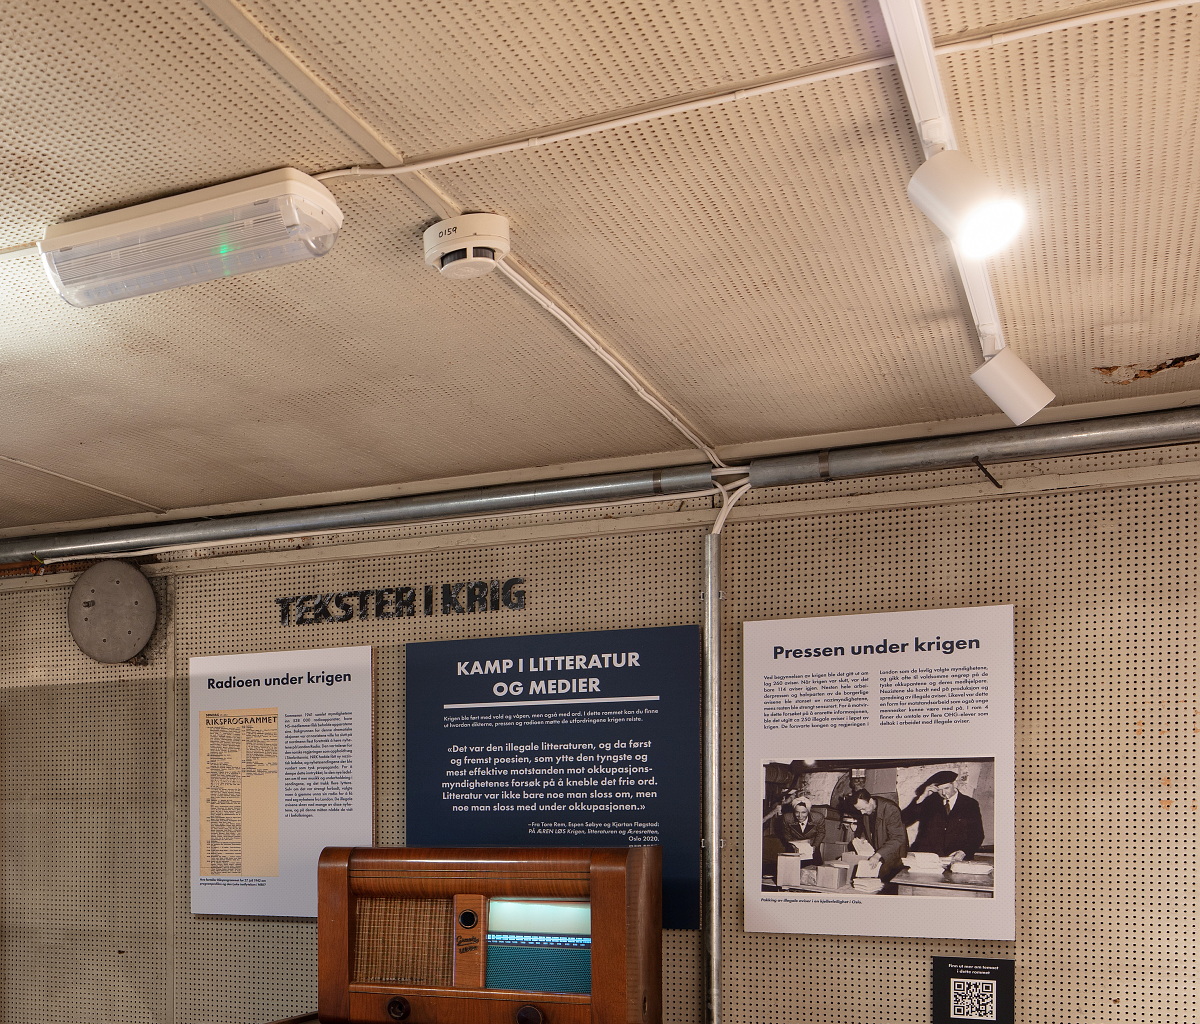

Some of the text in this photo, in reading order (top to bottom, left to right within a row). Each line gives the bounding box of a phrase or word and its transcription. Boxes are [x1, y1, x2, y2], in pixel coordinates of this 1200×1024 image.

[439, 227, 457, 238] 0159
[275, 578, 526, 627] TEKSTER I KRIG
[773, 636, 980, 660] Pressen under krigen
[457, 652, 640, 675] KAMP I LITTERATUR
[207, 671, 351, 689] Radioen under krigen
[493, 678, 601, 696] OG MEDIER
[206, 716, 277, 726] RIKSPROGRAMMET
[448, 744, 467, 752] «Det
[486, 743, 503, 751] den
[505, 742, 539, 753] illegale
[541, 741, 596, 752] litteraturen,
[628, 740, 652, 748] først
[463, 756, 491, 764] fremst
[493, 755, 531, 765] poesien,
[555, 754, 574, 764] ytte
[576, 754, 594, 762] den
[596, 753, 632, 763] tyngste
[446, 765, 653, 776] mest effektive motstanden mot okkupasjons-
[442, 779, 509, 789] myndighetenes
[511, 779, 540, 787] forsøk
[542, 778, 555, 788] på
[557, 778, 563, 786] å
[566, 778, 598, 786] kneble
[637, 777, 658, 785] ord.
[442, 791, 482, 799] Litteratur
[568, 802, 646, 812] okkupasjonen.»
